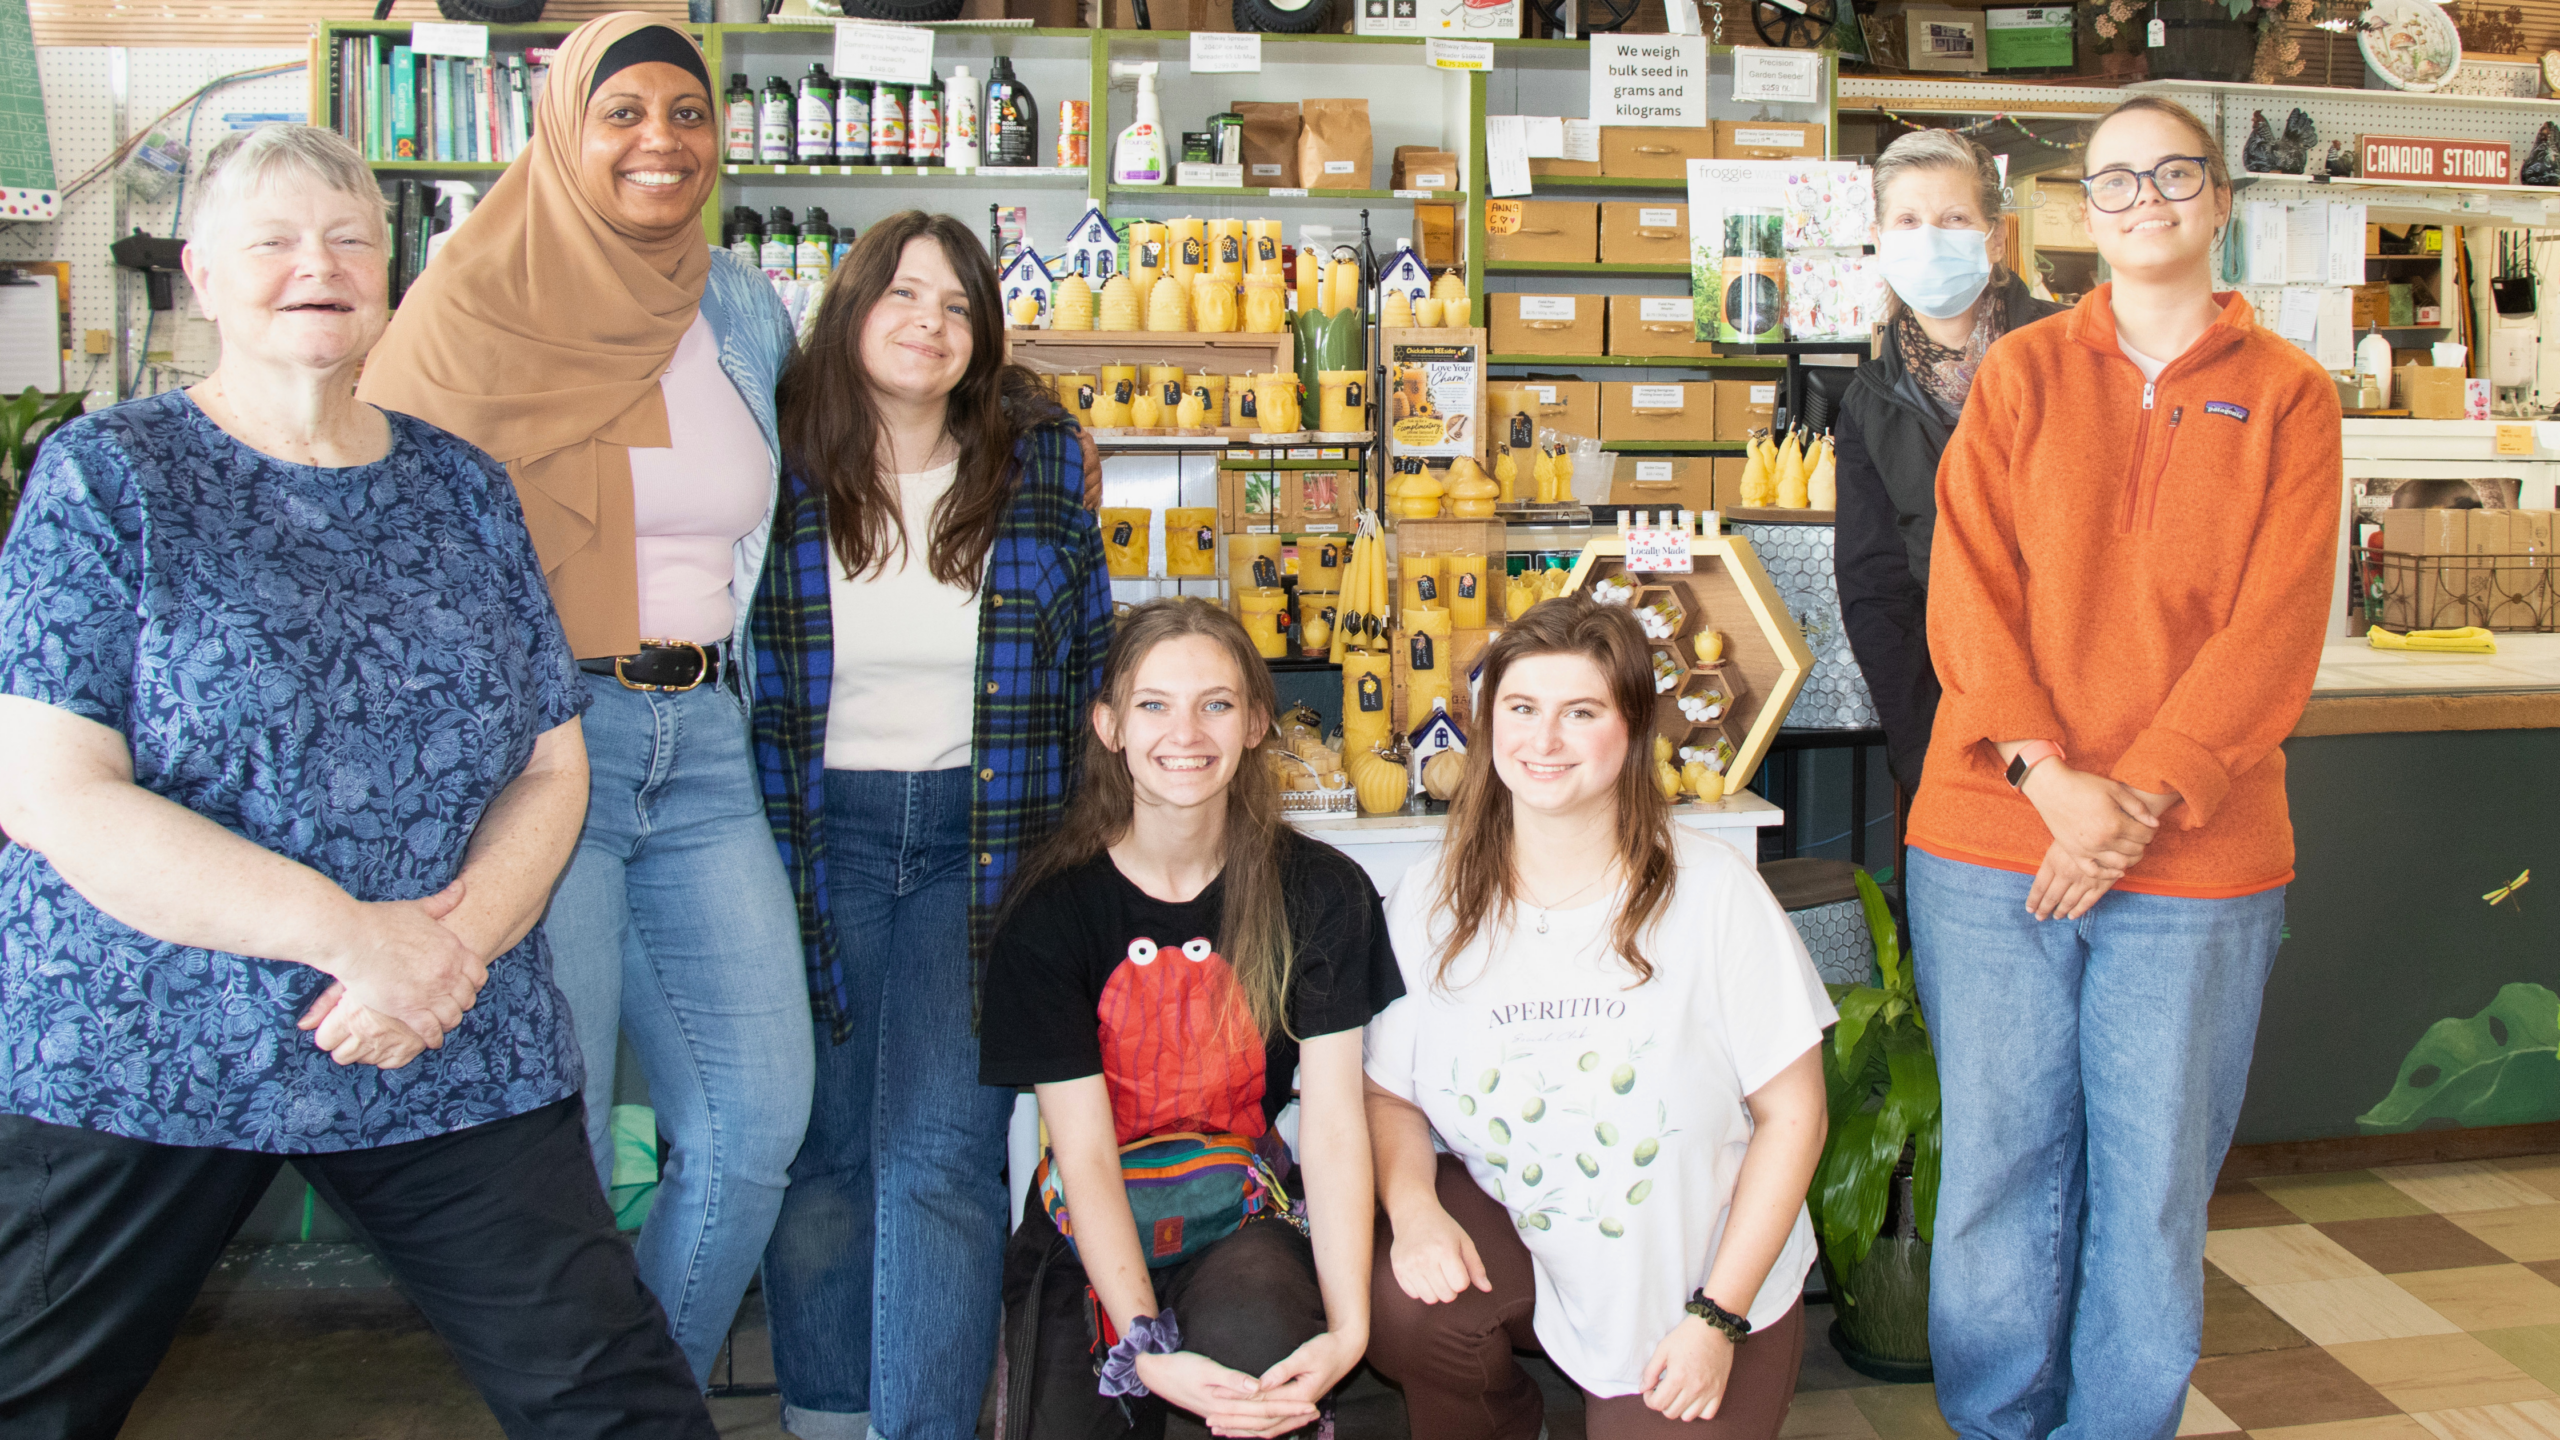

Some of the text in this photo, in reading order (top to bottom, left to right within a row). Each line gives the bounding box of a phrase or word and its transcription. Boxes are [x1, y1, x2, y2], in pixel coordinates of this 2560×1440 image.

[854, 31, 915, 41] Earthway Spreader
[885, 44, 900, 52] High
[1432, 41, 1460, 50] Earthway
[1434, 50, 1460, 59] Spreader
[1617, 45, 1680, 61] We weigh
[330, 36, 340, 96] BONSAI
[877, 56, 906, 64] capacity
[1759, 58, 1794, 67] Precision
[1608, 64, 1688, 77] bulk seed in
[1749, 70, 1804, 80] Garden Seeder
[1613, 85, 1683, 99] grams and
[396, 83, 408, 128] Gardening
[1616, 104, 1682, 119] kilograms
[2366, 144, 2507, 178] CANADA STRONG
[1698, 164, 1752, 183] froggie
[1490, 202, 1519, 213] ANNA
[1490, 225, 1507, 234] BIN
[1431, 363, 1473, 372] Love Your
[1430, 371, 1470, 386] Charm?
[2207, 407, 2244, 420] patagonia
[1400, 422, 1442, 435] complimentary
[2353, 483, 2393, 508] PINEBUSH
[1630, 546, 1686, 557] Locally Made
[1488, 996, 1626, 1030] APERITIVO
[1556, 1026, 1589, 1043] Club
